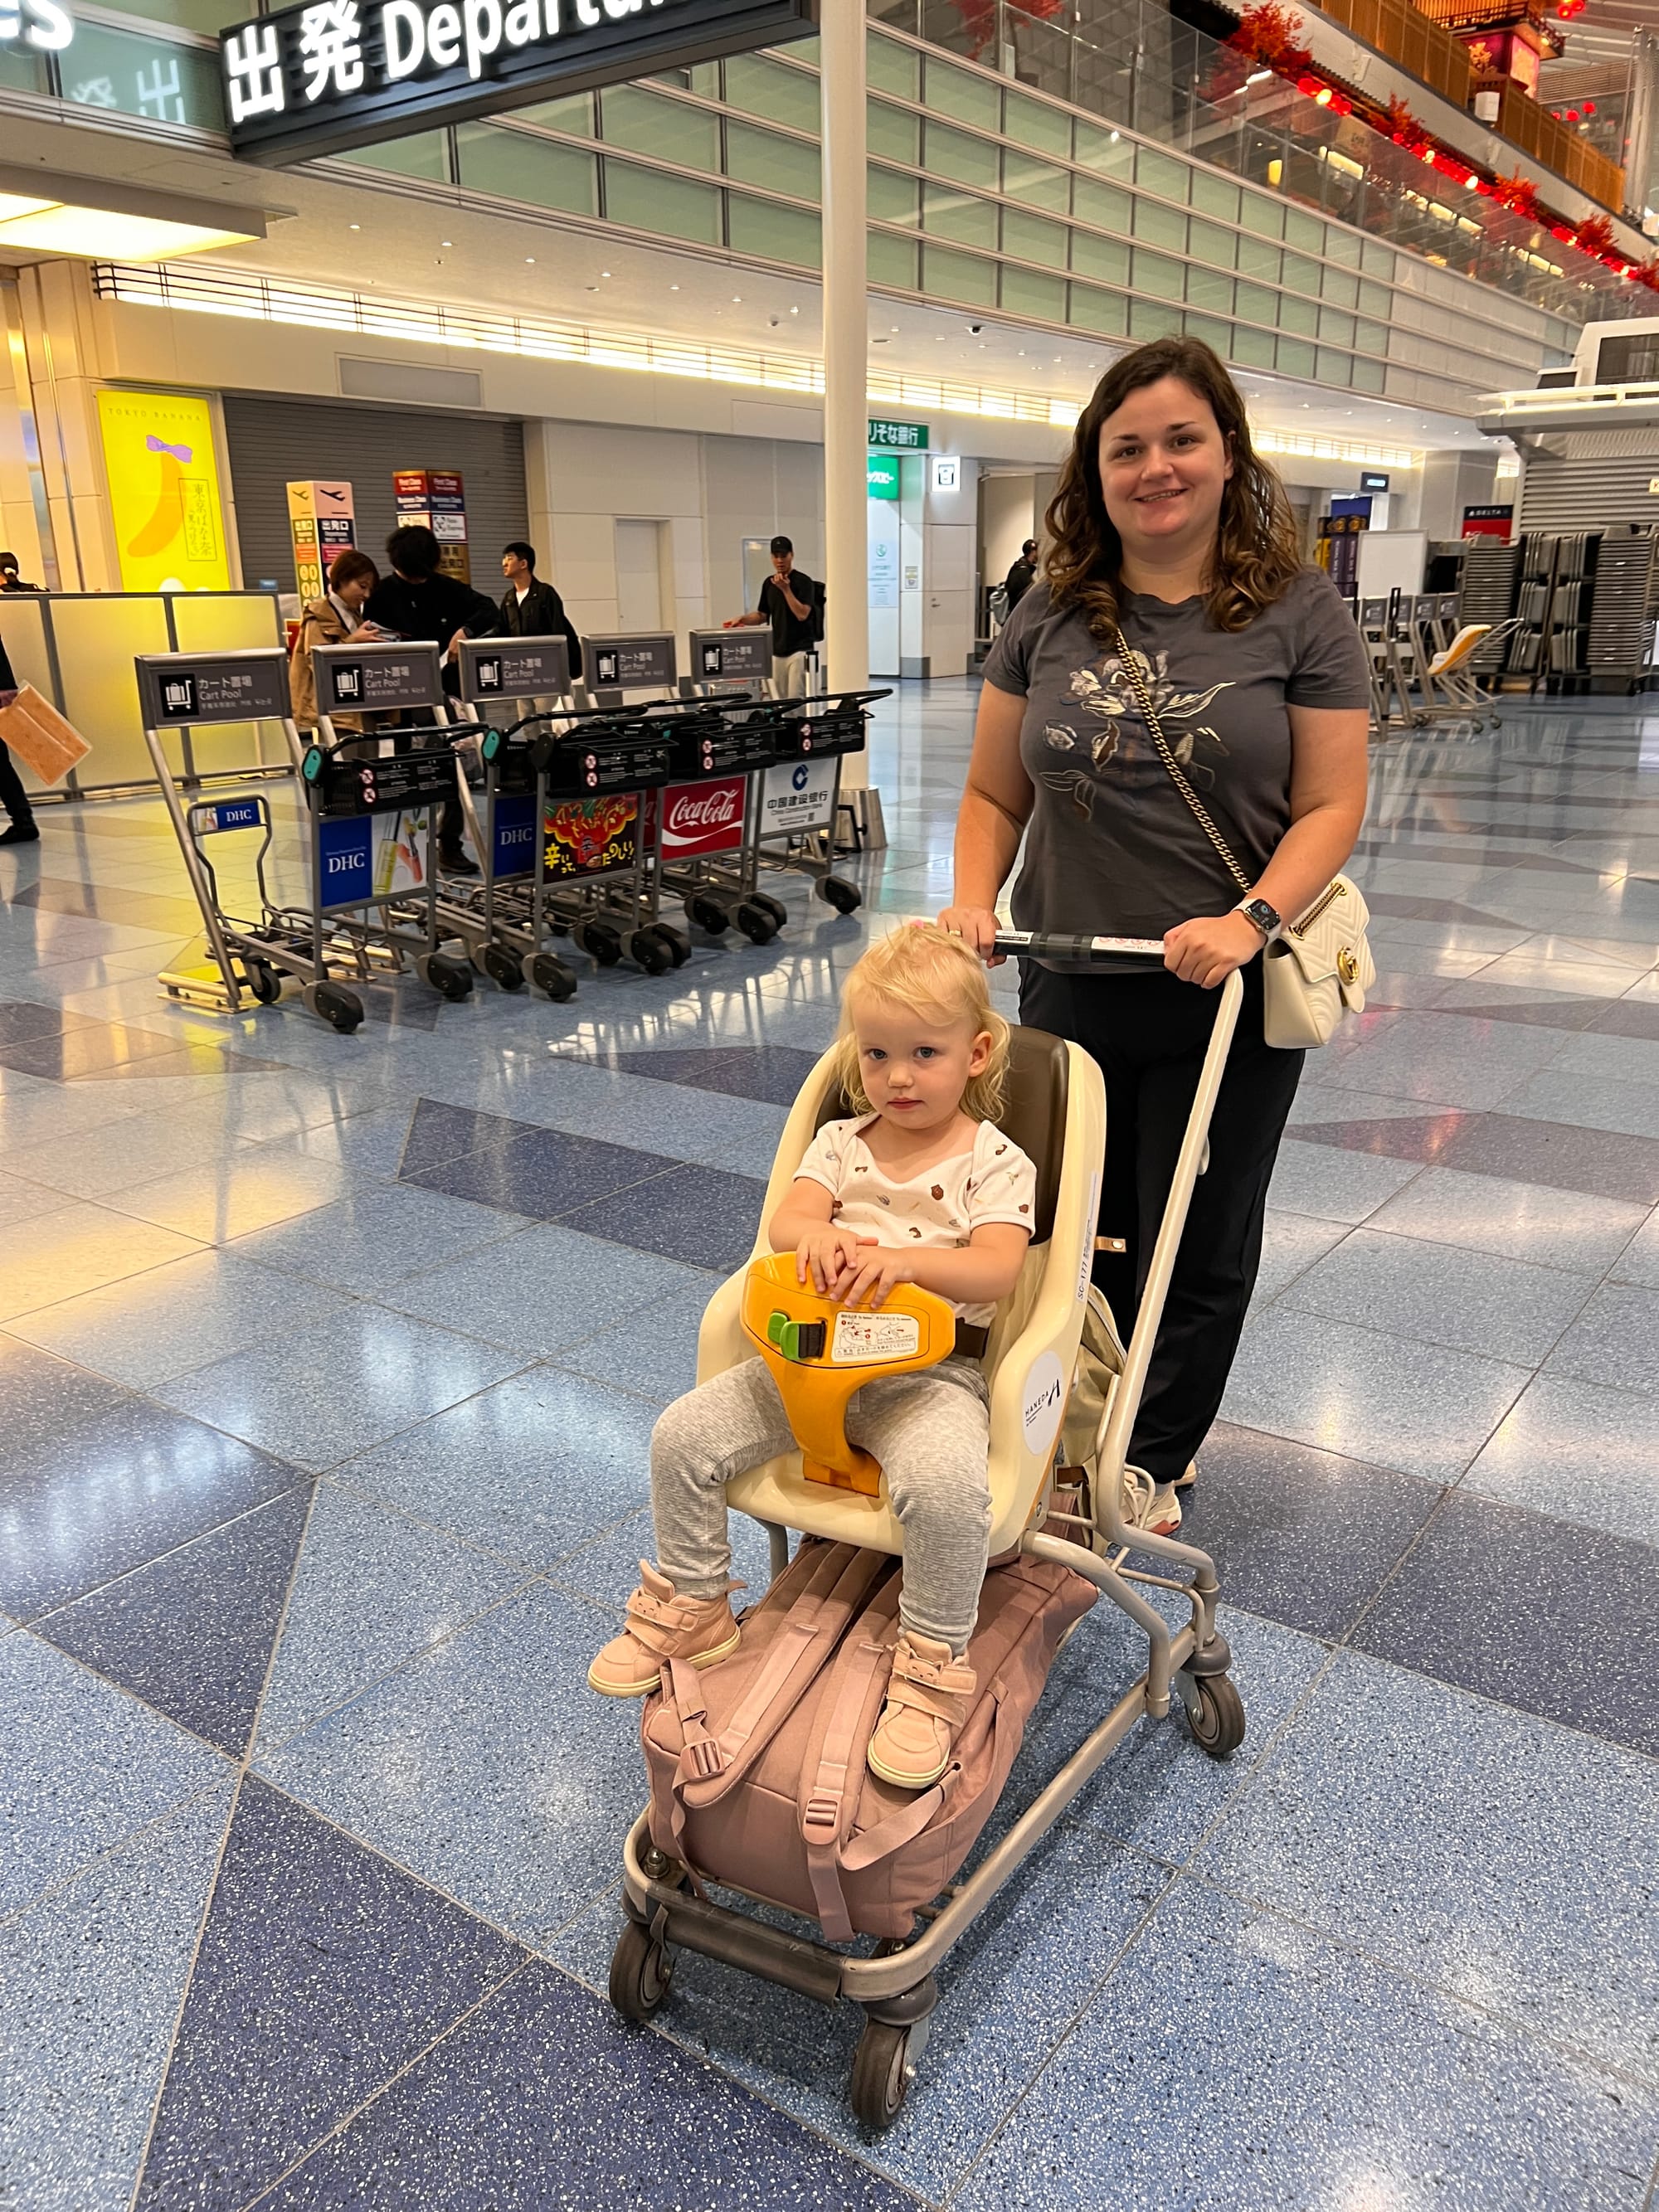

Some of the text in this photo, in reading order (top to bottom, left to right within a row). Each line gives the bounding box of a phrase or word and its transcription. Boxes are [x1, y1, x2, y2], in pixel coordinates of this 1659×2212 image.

[226, 0, 366, 123] 出発
[108, 408, 200, 421] TOKYO BANANA
[365, 678, 401, 688] Cart Pool
[199, 689, 241, 700] Cart Pool
[226, 809, 251, 822] DHC
[501, 828, 533, 845] DHC
[328, 853, 365, 873] DHC
[1025, 1390, 1048, 1417] HANEDA
